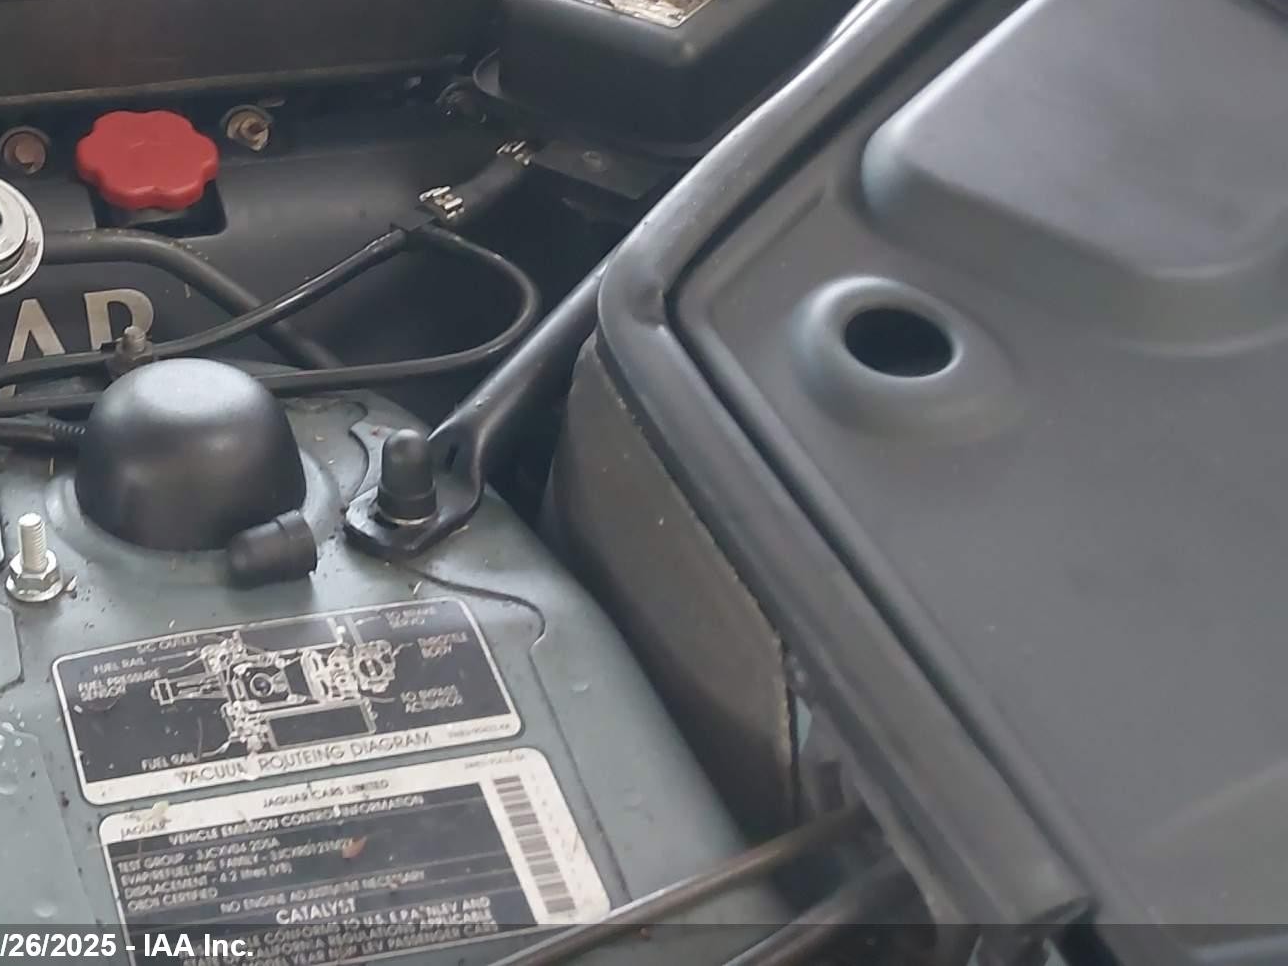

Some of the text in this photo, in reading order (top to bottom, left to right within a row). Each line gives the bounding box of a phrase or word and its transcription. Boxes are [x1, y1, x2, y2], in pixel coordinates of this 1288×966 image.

[93, 656, 147, 674] FUEL RAIL
[259, 745, 345, 772] ROUTEING
[350, 731, 432, 759] DIAGRAM
[141, 754, 169, 770] FUEL
[264, 791, 309, 808] JAGUAR
[312, 786, 344, 801] CARS
[168, 828, 218, 846] VEHICLE
[341, 795, 424, 818] INFORMATION
[117, 860, 142, 874] TEST
[220, 900, 241, 915] NO
[275, 897, 357, 925] CATALYST
